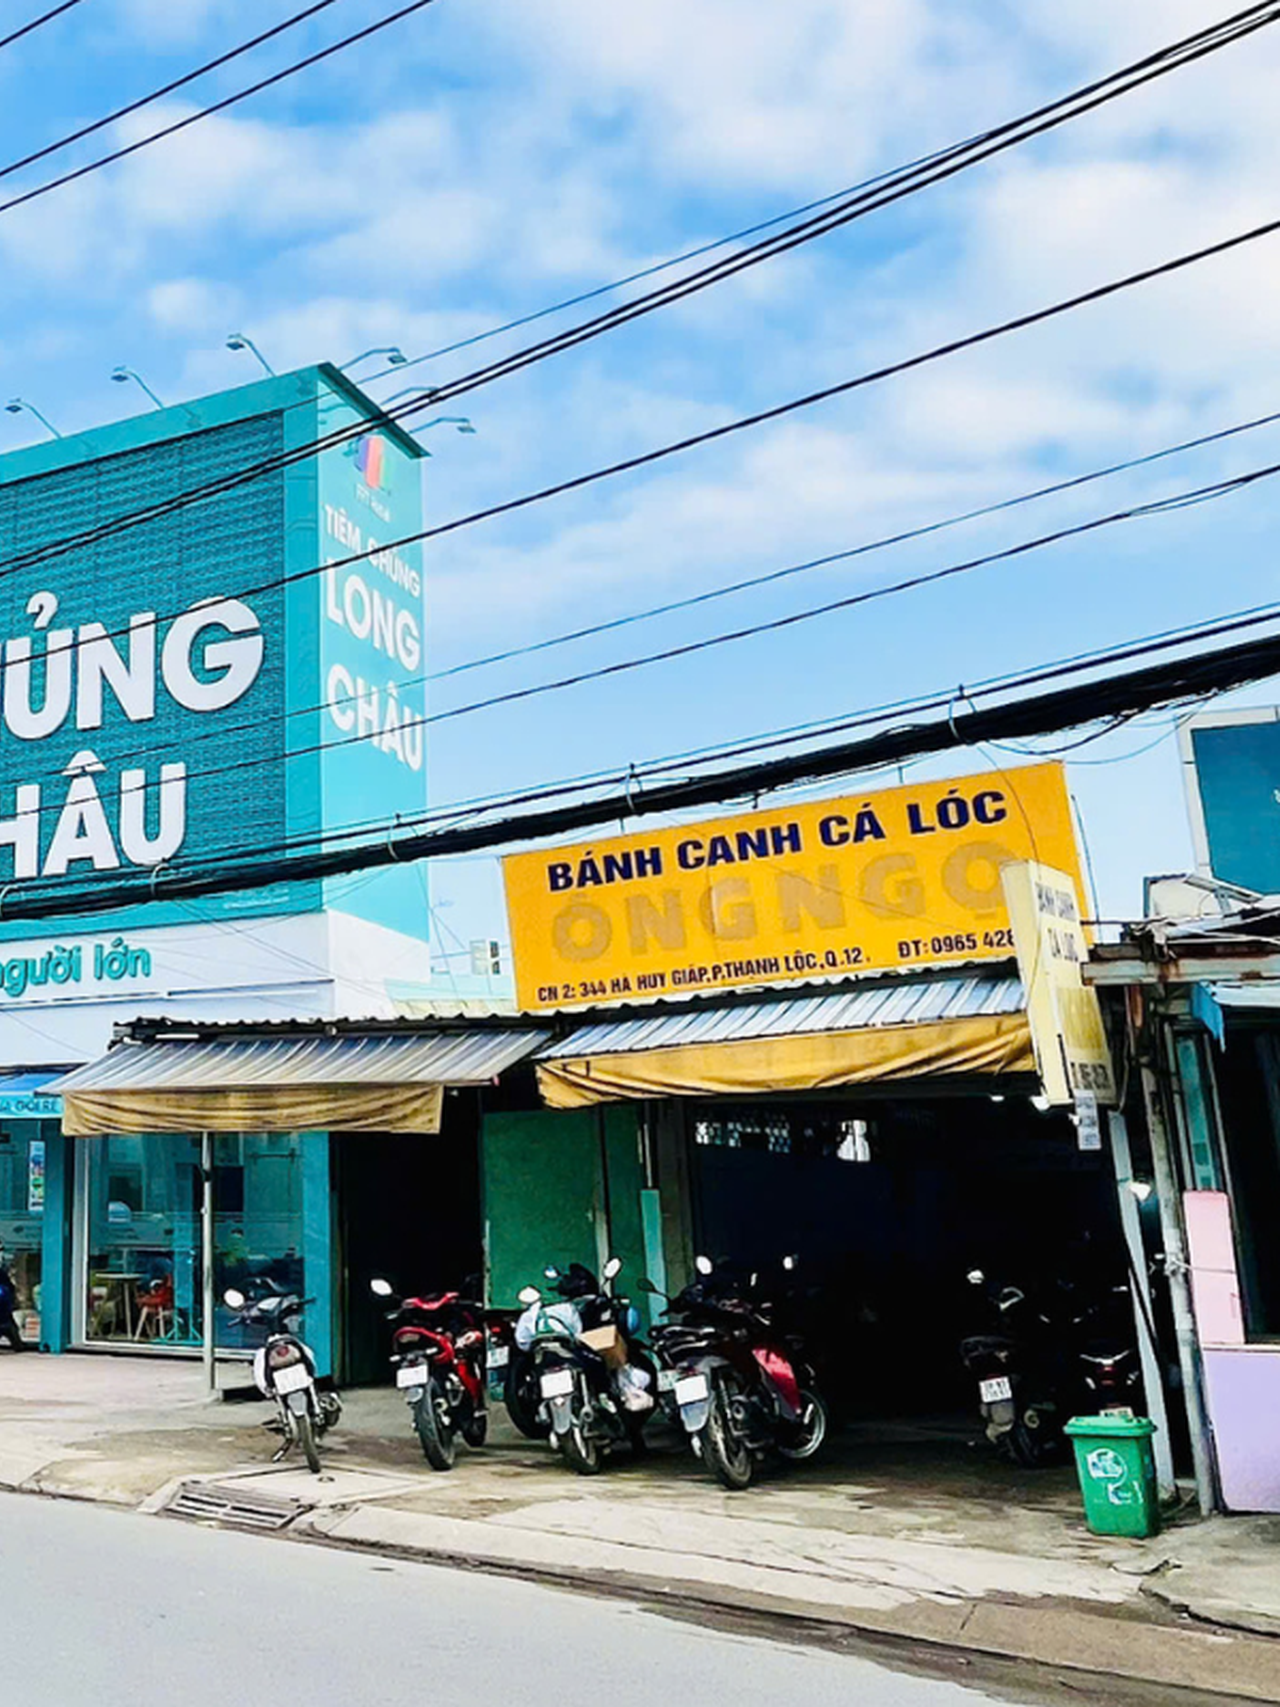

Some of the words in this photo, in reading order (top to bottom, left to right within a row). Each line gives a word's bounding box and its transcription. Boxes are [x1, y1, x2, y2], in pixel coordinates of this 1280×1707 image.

[323, 503, 362, 556] TIÊM
[325, 556, 421, 672] LONG
[326, 662, 422, 772] CHÂU
[547, 850, 662, 892] BÁNH
[677, 822, 803, 870] CANH
[818, 802, 886, 847] CÁ
[906, 788, 1008, 835] LÓC
[92, 938, 152, 981] lớn
[538, 987, 558, 1002] CN
[562, 984, 576, 999] 2:
[579, 980, 607, 998] 344
[637, 973, 666, 991] HUY
